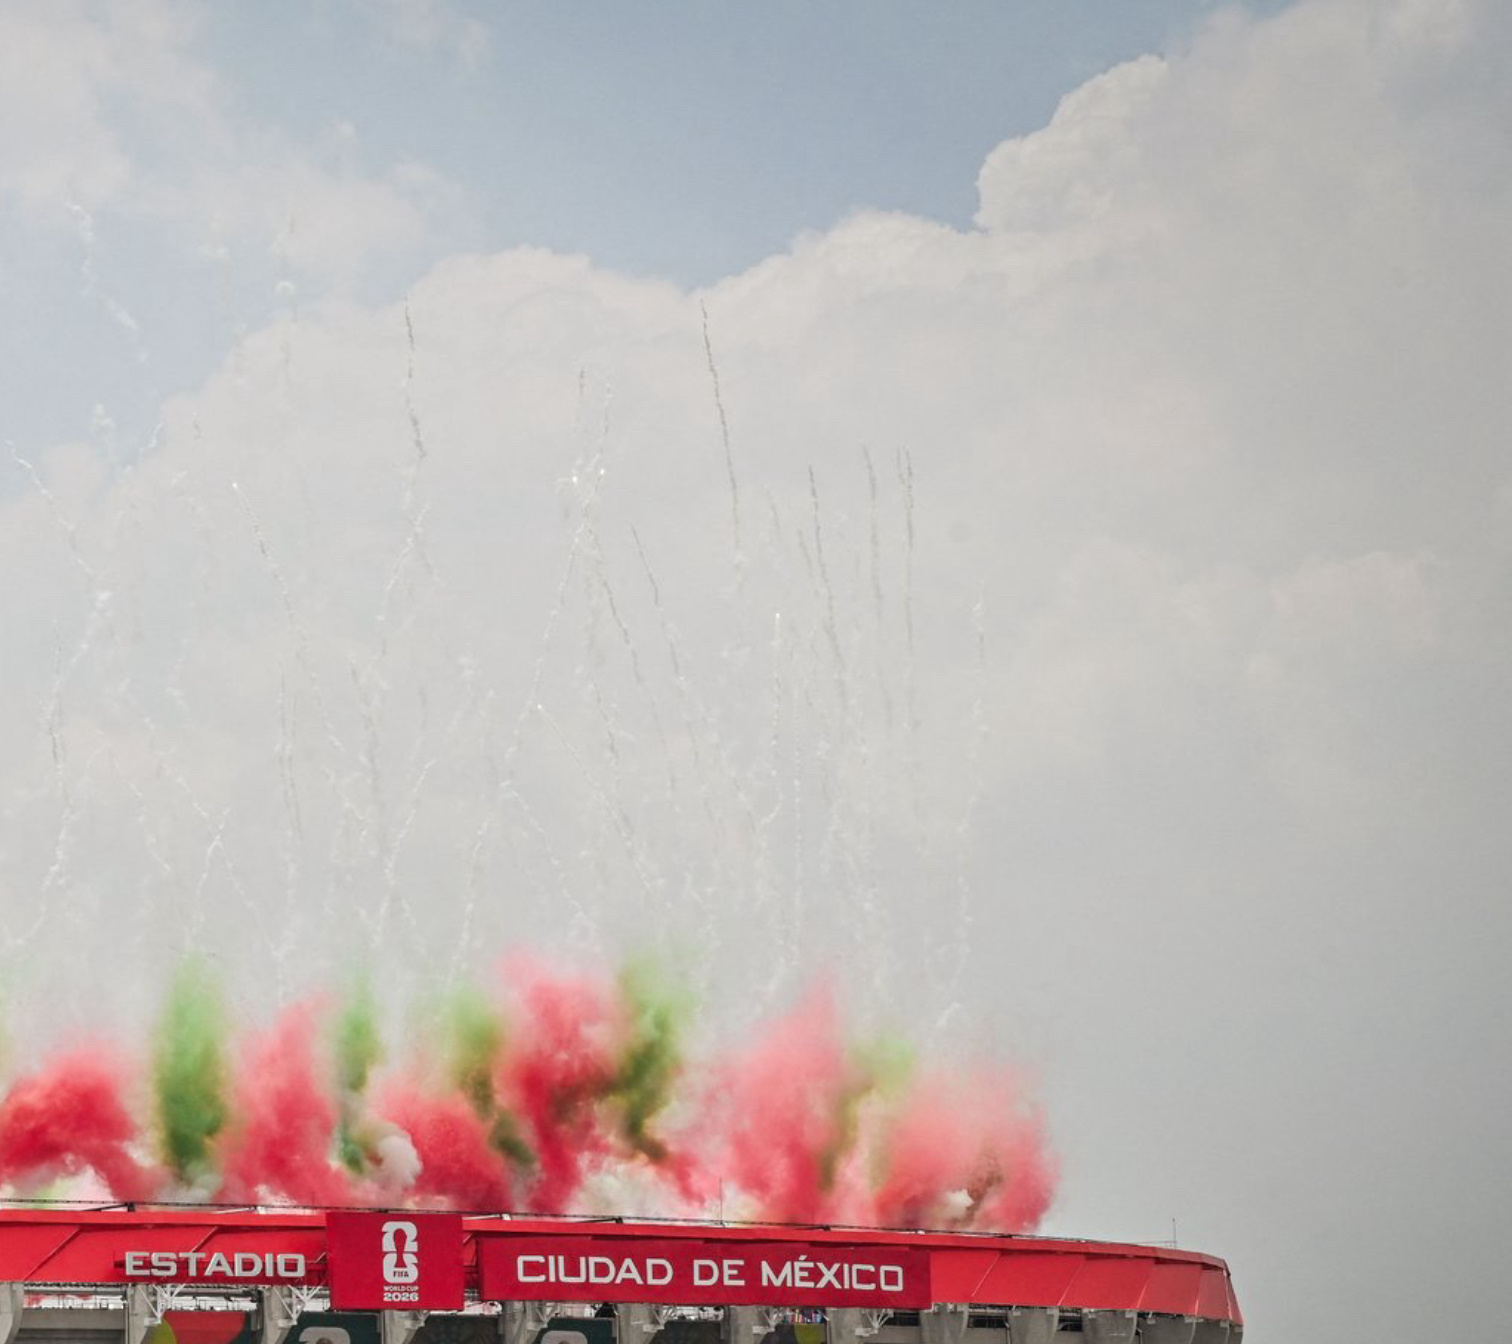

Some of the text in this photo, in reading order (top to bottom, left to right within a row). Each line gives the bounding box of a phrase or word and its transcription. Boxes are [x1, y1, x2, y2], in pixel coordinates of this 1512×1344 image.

[125, 1251, 306, 1277] ESTADIO
[516, 1254, 904, 1292] CIUDAD DE MÉXICO
[393, 1270, 409, 1278] FIFA
[383, 1292, 419, 1302] 2026
